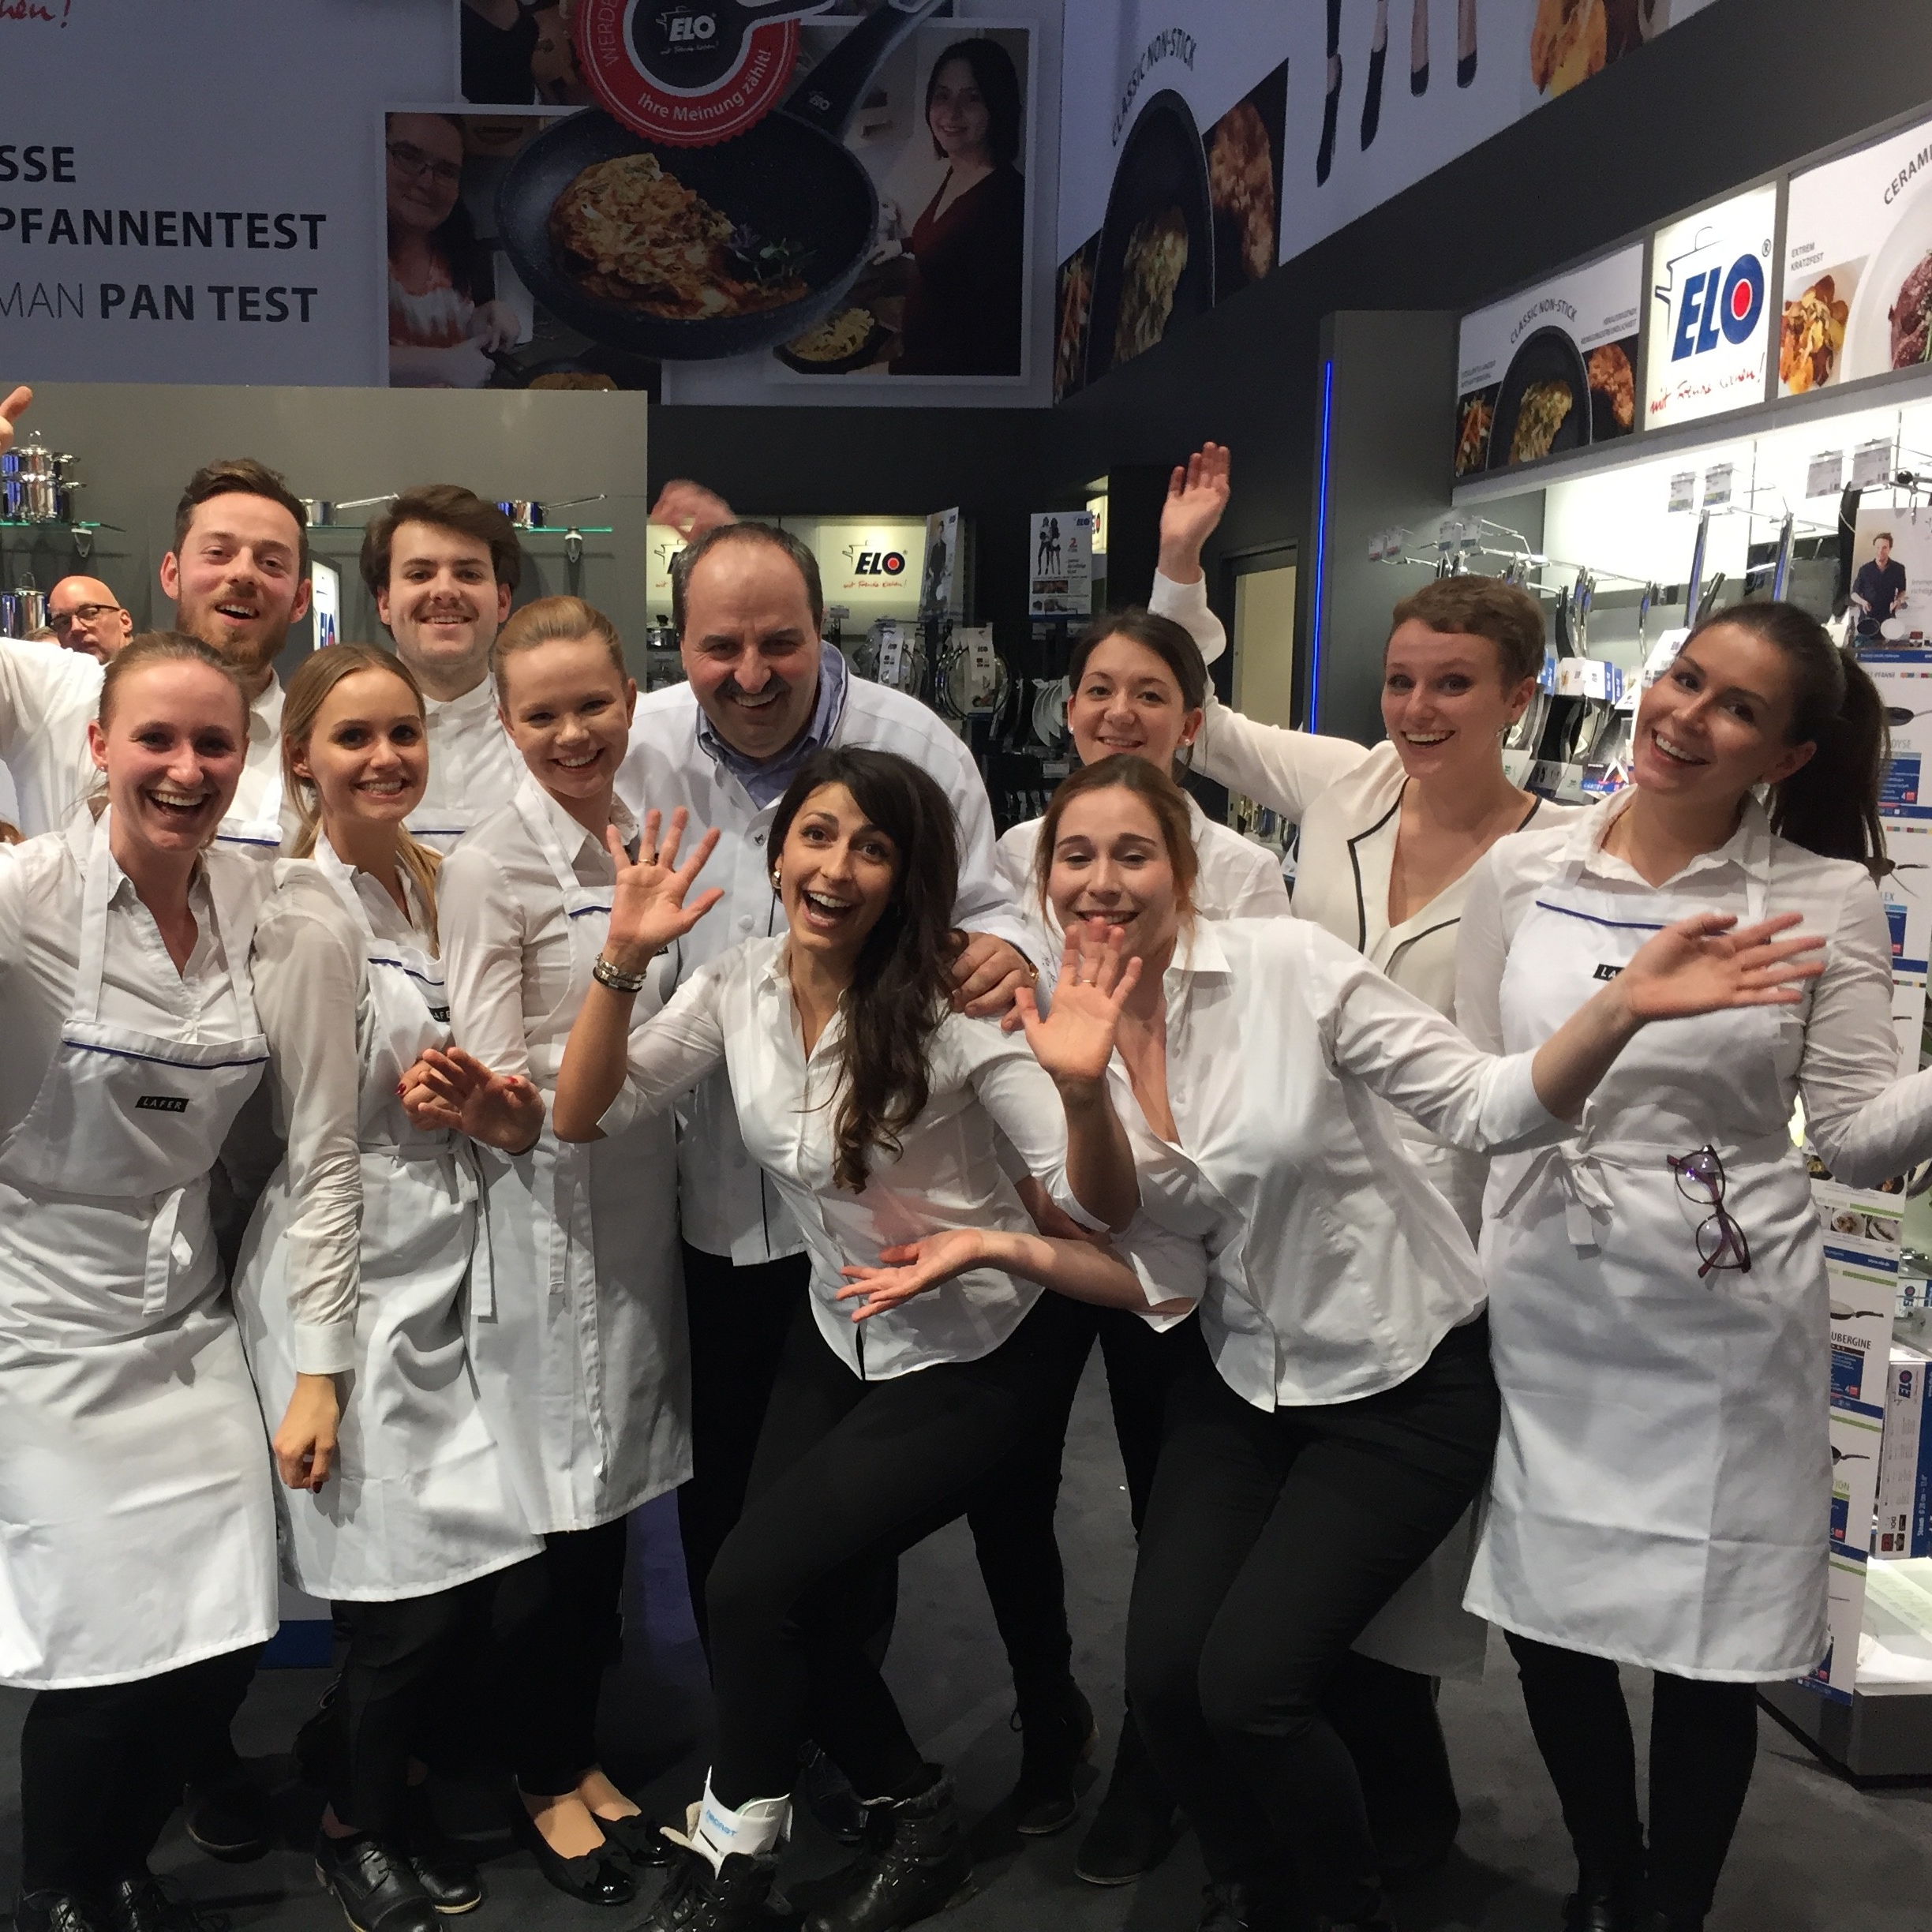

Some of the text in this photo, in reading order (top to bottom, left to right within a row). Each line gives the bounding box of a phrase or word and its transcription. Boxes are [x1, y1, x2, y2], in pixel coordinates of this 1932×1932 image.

[669, 15, 716, 41] ELO
[638, 50, 771, 121] Ihre Meinung zählt!
[1112, 53, 1145, 147] CLASSIC
[0, 144, 77, 183] SSE
[99, 283, 196, 321] PAN
[207, 285, 318, 323] TEST
[1511, 304, 1538, 344] CLASSIC
[1539, 298, 1578, 322] NON-STICK
[1671, 253, 1765, 362] ELO
[855, 552, 905, 575] ELO
[142, 1097, 182, 1110] LAFER
[1831, 1331, 1872, 1350] UBERGINE
[1898, 1369, 1913, 1399] ELO
